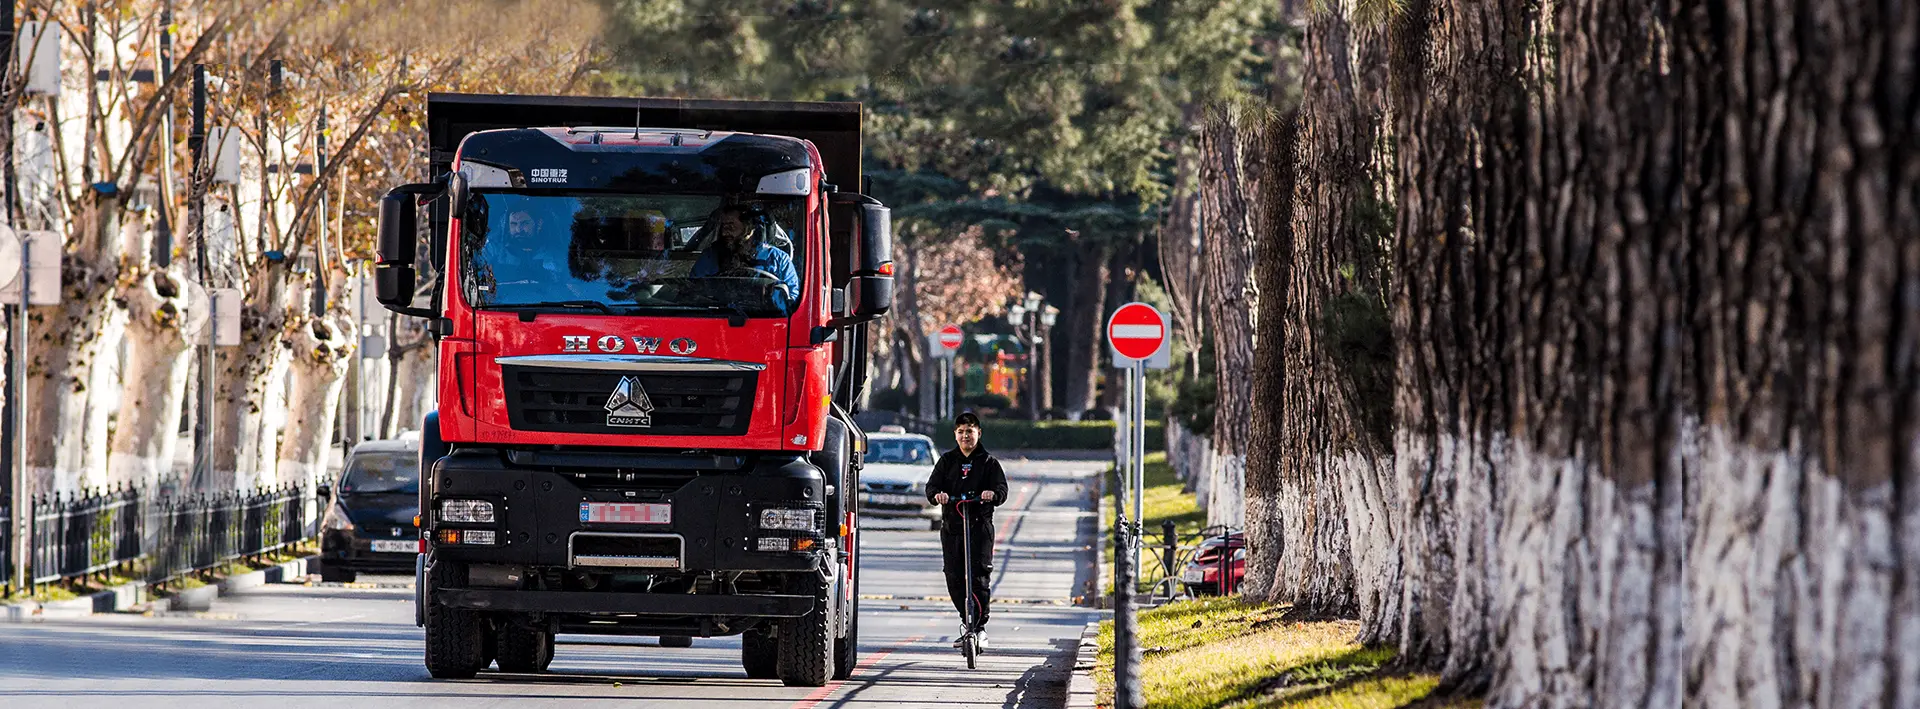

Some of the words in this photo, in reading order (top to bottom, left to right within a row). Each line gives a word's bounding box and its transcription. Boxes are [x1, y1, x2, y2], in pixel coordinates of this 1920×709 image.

[531, 168, 568, 178] 中国重汽
[562, 335, 698, 355] HOWO
[609, 417, 648, 425] CNHTC
